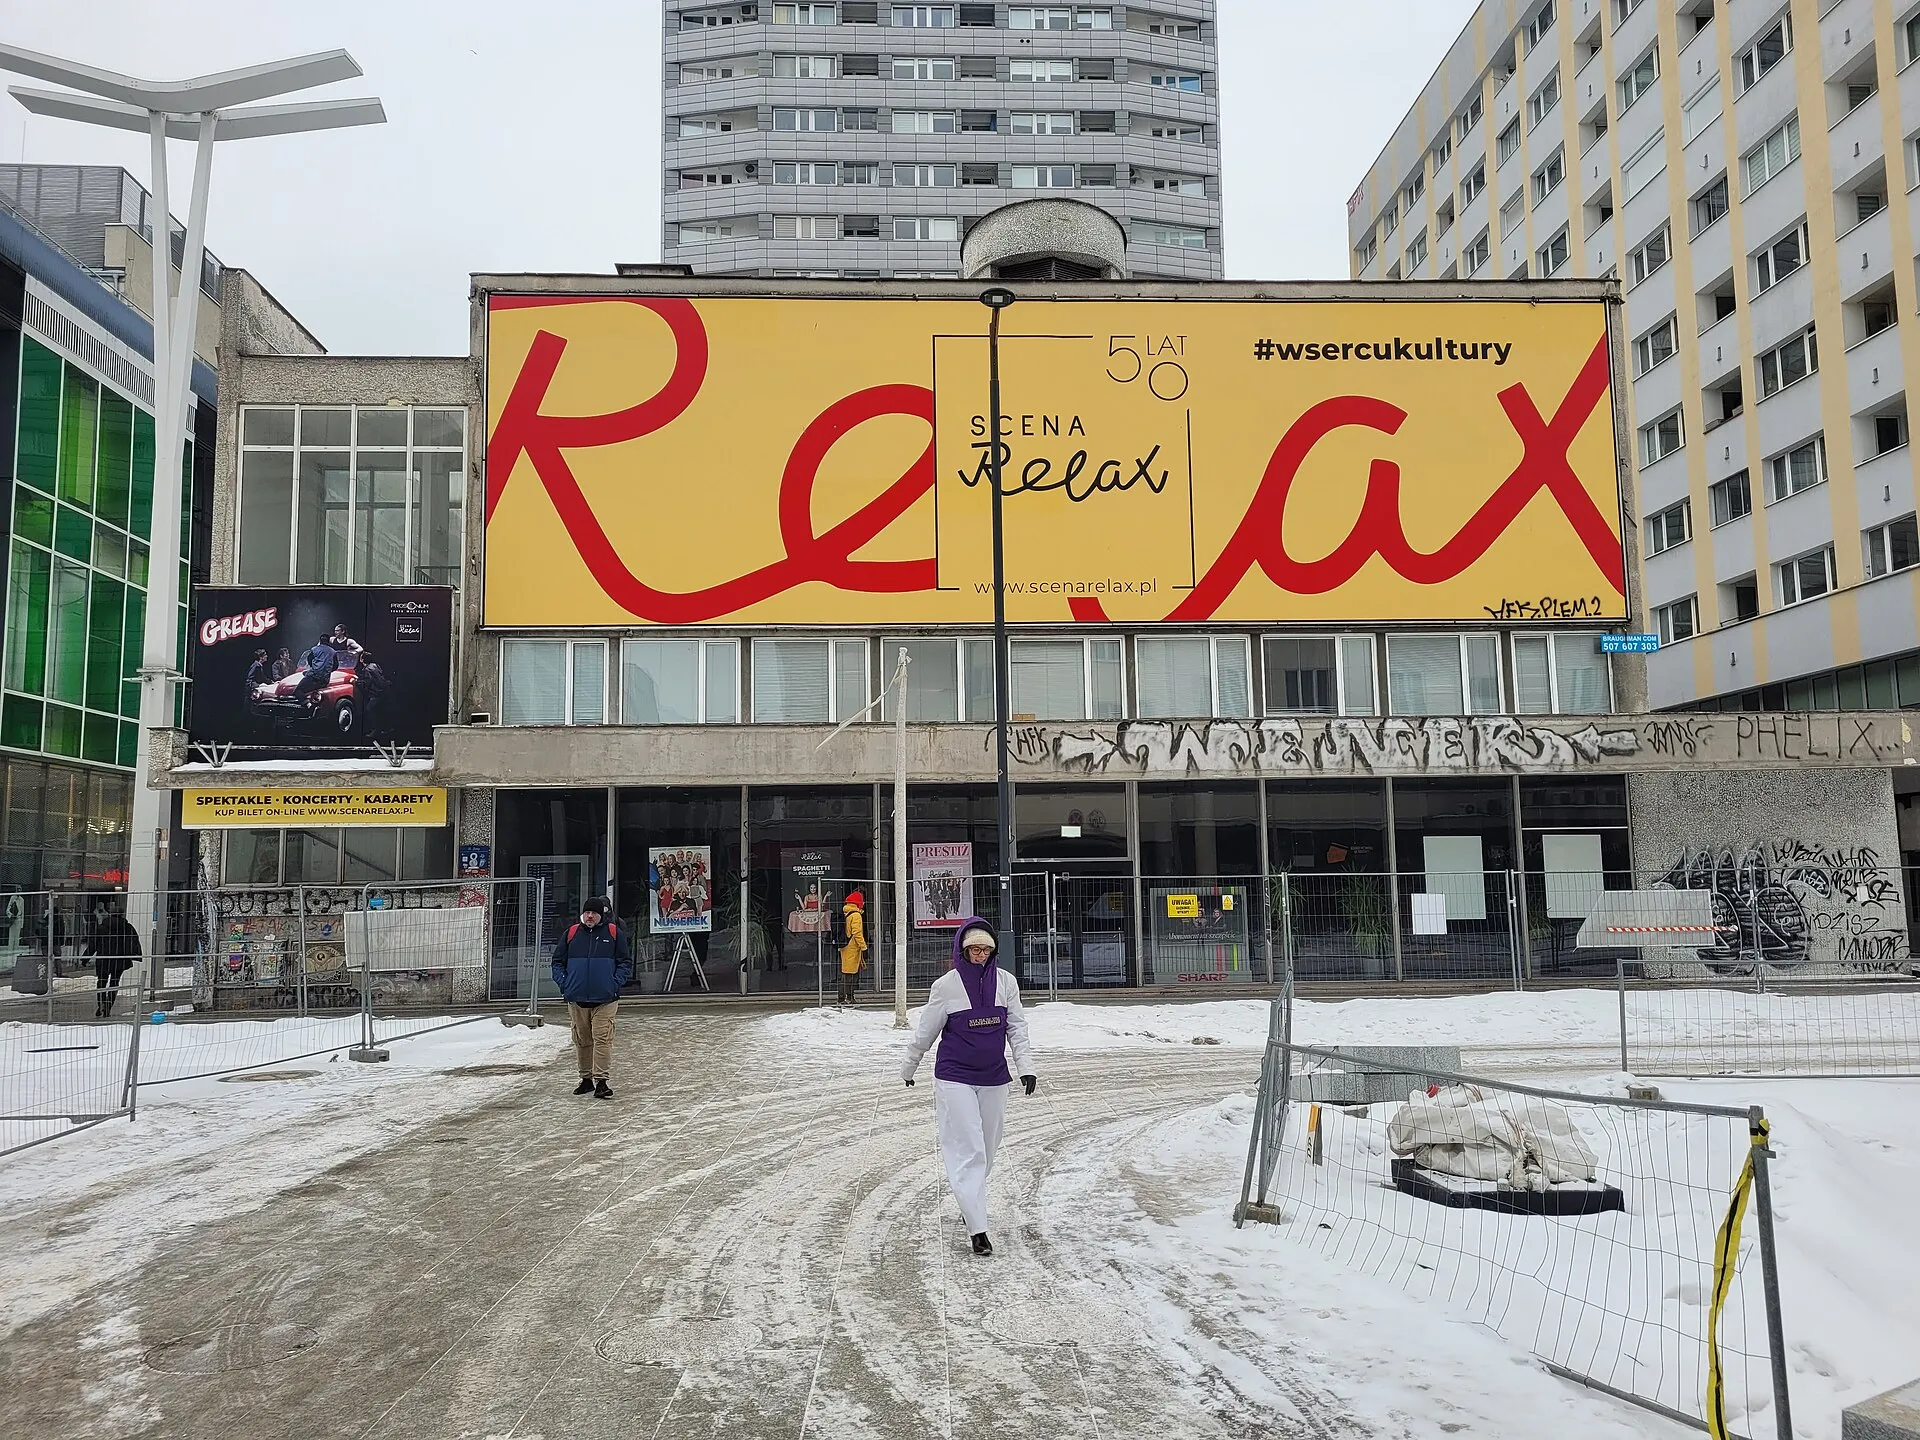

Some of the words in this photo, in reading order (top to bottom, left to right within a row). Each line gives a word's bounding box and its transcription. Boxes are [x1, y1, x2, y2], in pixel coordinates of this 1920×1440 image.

[1147, 335, 1188, 356] LAT
[1254, 337, 1512, 366] #wsercukultury
[1106, 335, 1189, 401] 50
[970, 415, 1086, 437] SCENA
[958, 444, 1169, 502] Relax
[201, 607, 278, 645] GREASE
[1603, 642, 1619, 651] 507
[1622, 642, 1638, 651] 607
[1641, 642, 1657, 651] 303
[196, 795, 273, 806] SPEKTAKLE
[282, 794, 354, 805] KONCERTY
[363, 794, 434, 804] KABARETY
[214, 808, 235, 817] KUP
[237, 808, 264, 816] BILET
[265, 808, 306, 816] ON-LINE
[307, 806, 416, 816] WWW.SCENARELAX.PL
[653, 915, 708, 927] NUMEREK
[1176, 973, 1229, 982] SHARP
